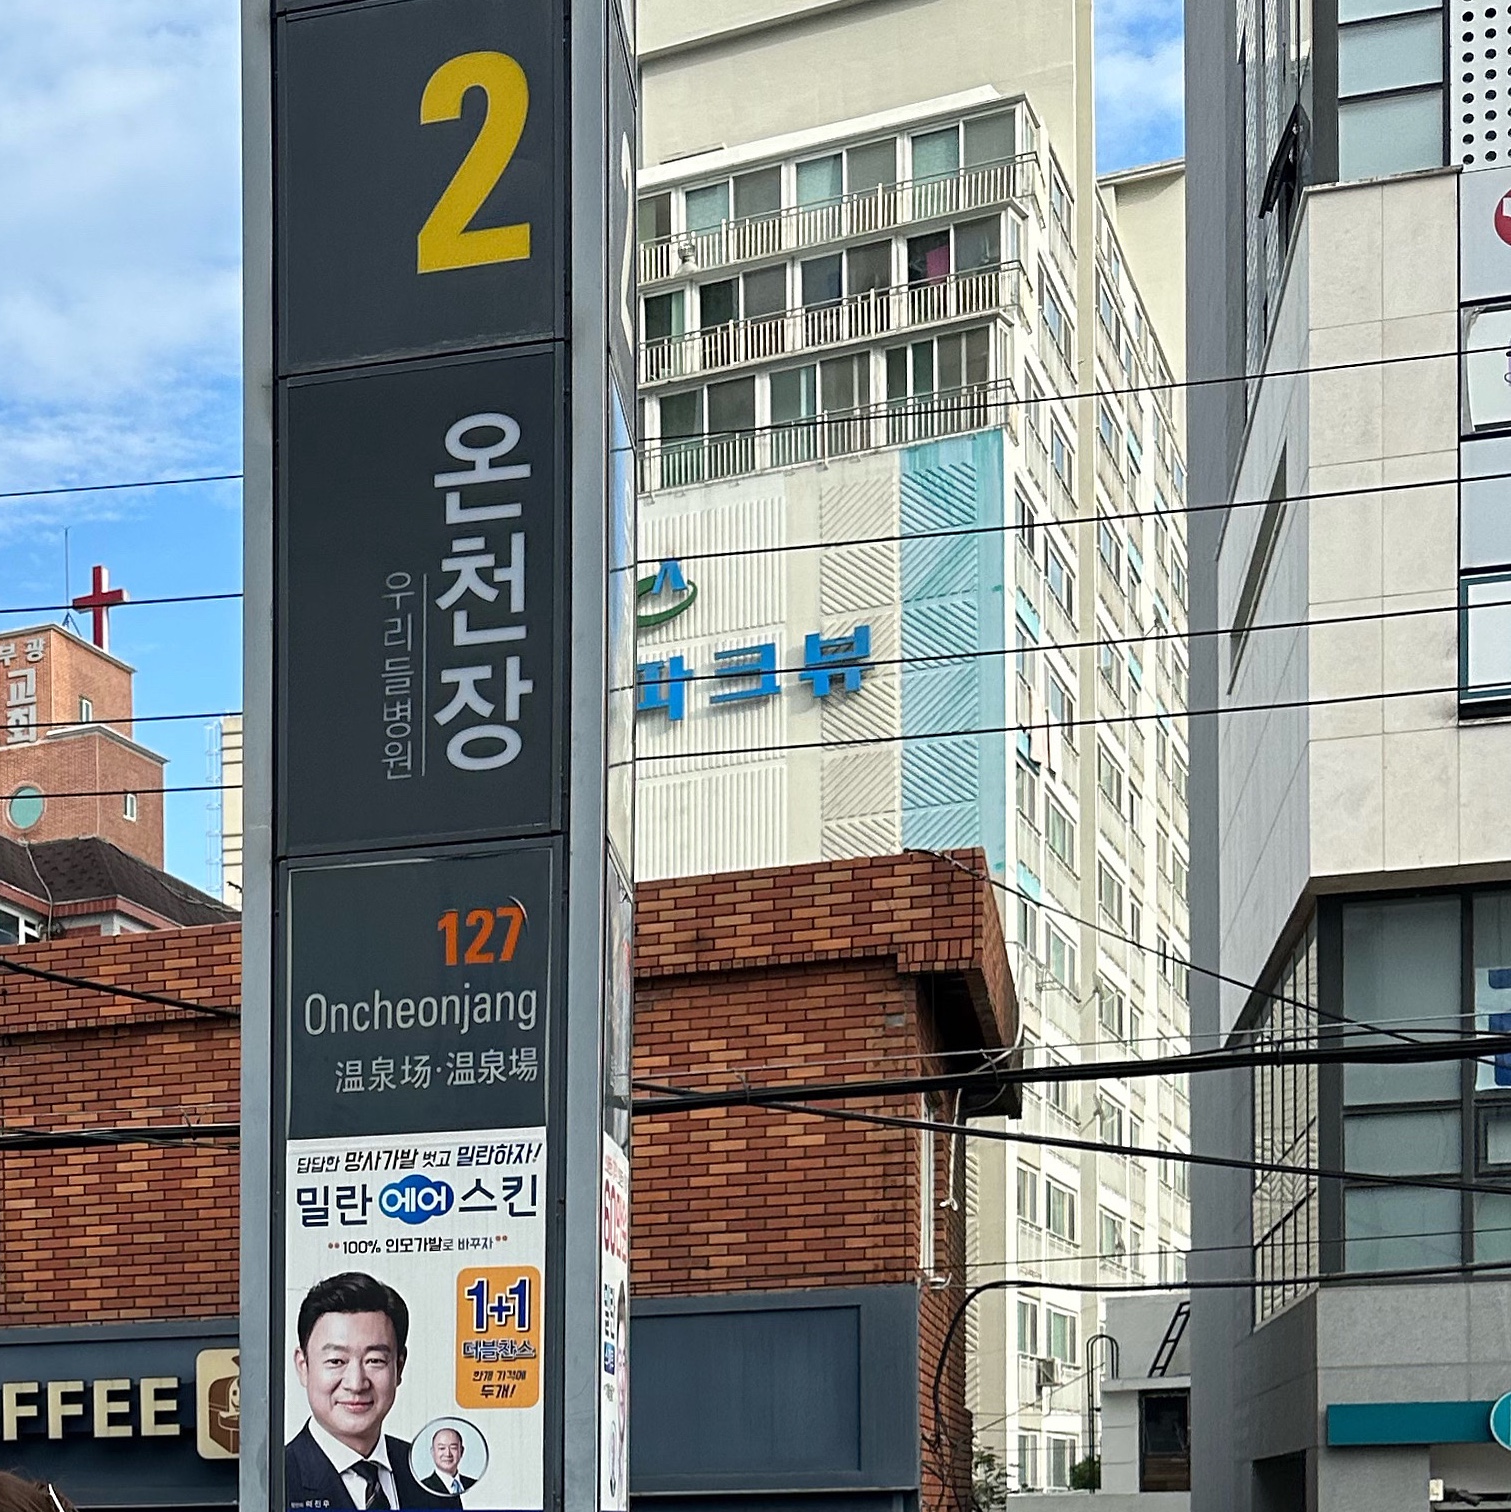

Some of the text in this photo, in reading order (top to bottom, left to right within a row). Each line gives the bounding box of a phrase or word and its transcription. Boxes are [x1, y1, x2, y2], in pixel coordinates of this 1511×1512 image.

[417, 50, 531, 275] 2
[433, 412, 533, 771] 온천장
[381, 571, 414, 780] 우리들병원
[637, 624, 877, 722] 파크뷰
[6, 667, 38, 745] 교회
[437, 905, 527, 967] 127
[304, 982, 537, 1035] Oncheonjang
[297, 1143, 543, 1174] 답답한 망사가발 벗고 밀란하자!
[296, 1174, 538, 1228] 밀란 에어 스킨
[342, 1236, 494, 1255] 100% 인모가발로 바꾸자
[465, 1277, 531, 1332] 1+1
[463, 1339, 536, 1362] 더블찬스
[480, 1384, 517, 1399] 두개!
